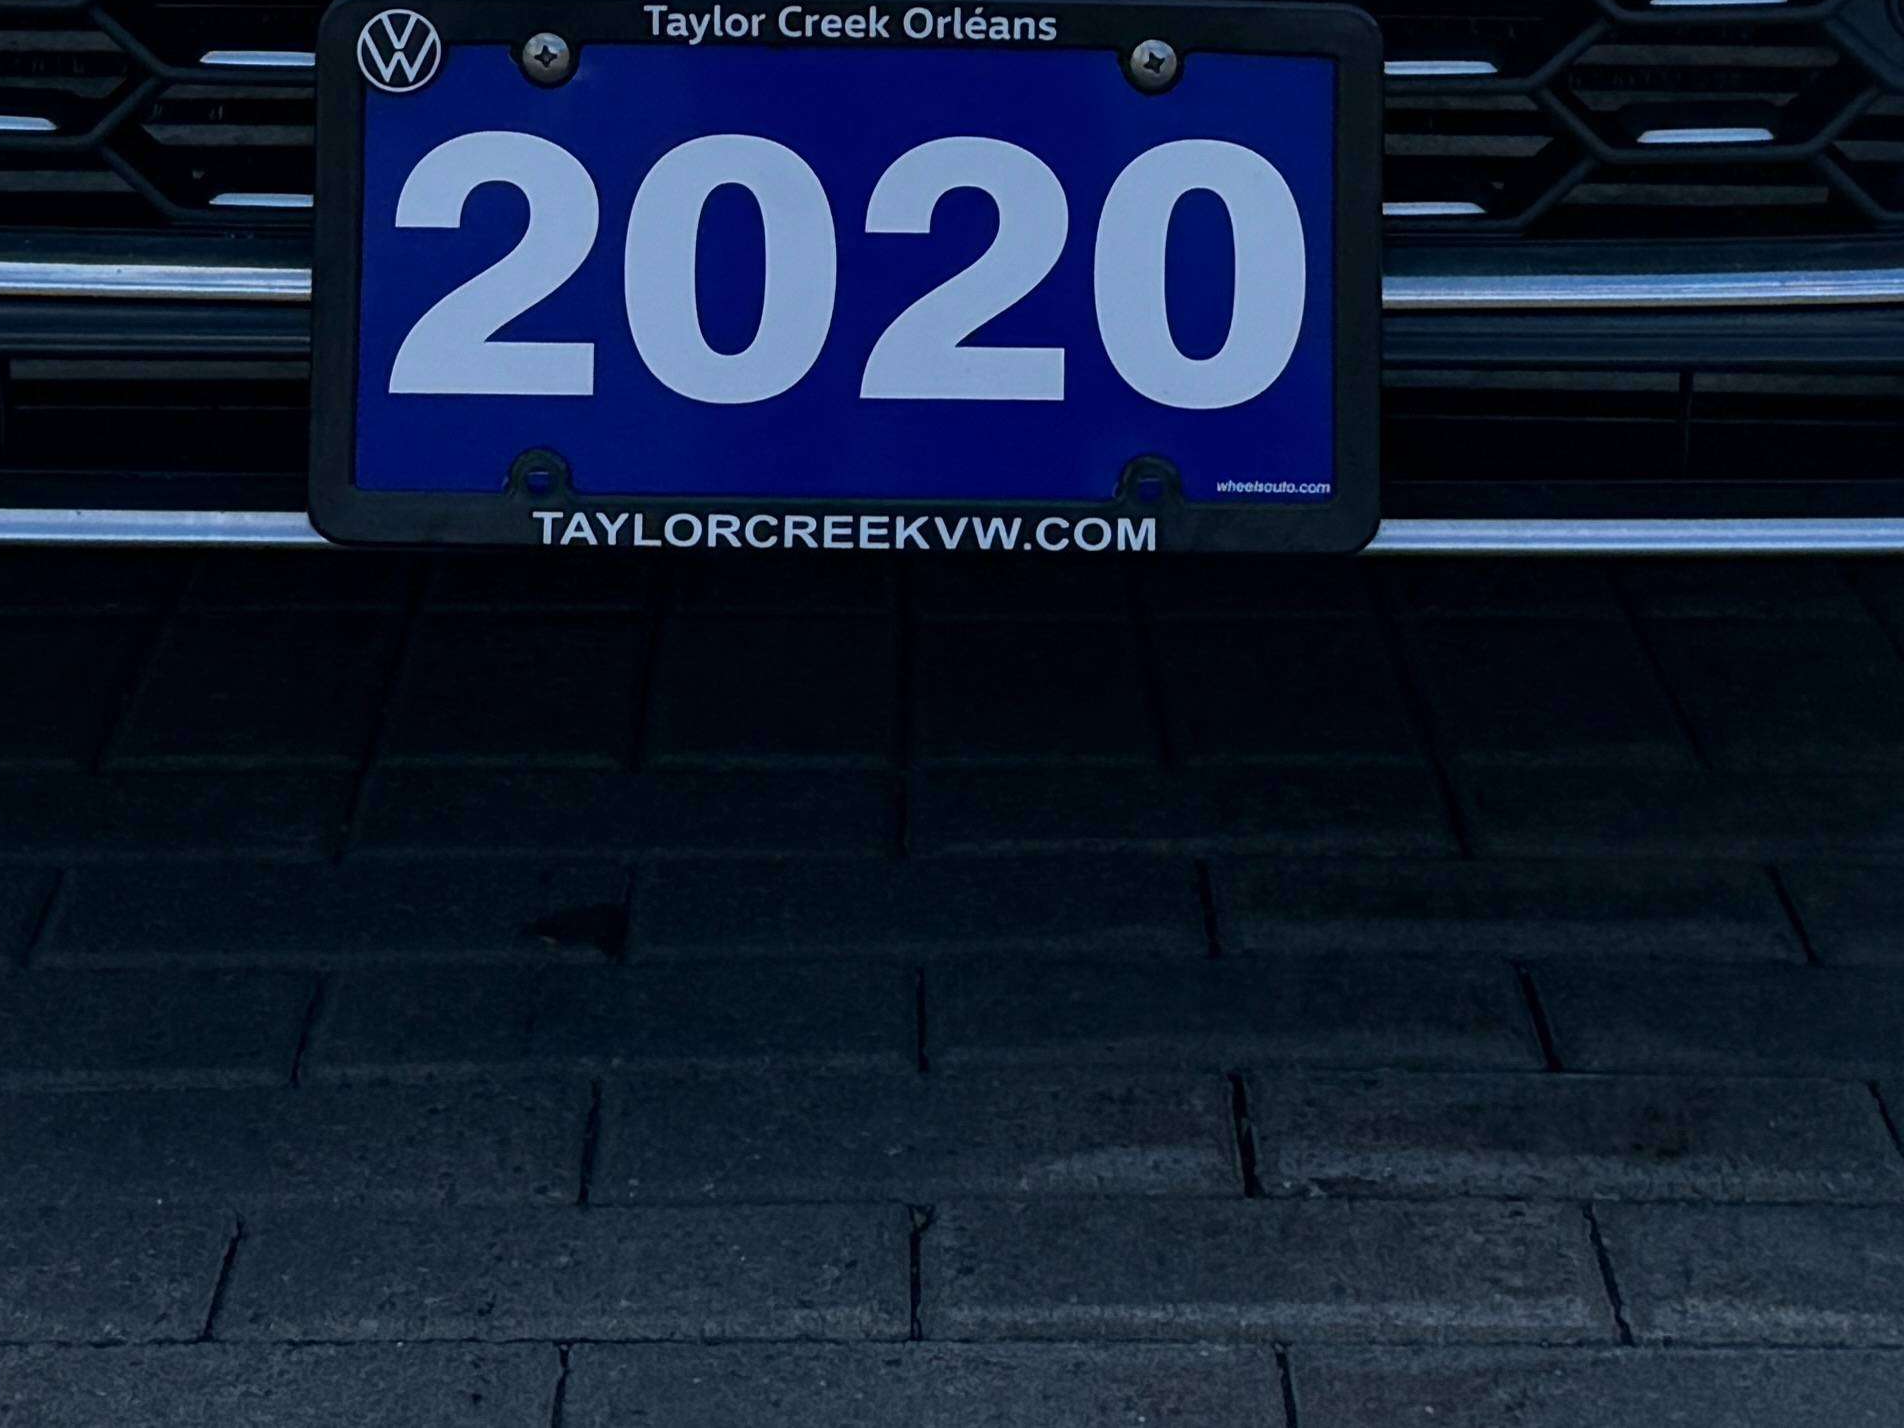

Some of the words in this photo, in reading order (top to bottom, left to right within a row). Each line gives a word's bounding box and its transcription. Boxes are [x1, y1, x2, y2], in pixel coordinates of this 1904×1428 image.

[643, 4, 766, 45] Taylor
[778, 5, 890, 39] Creek
[903, 6, 1057, 41] Orléans
[388, 130, 1307, 410] 2020
[532, 510, 1157, 552] TAYLORCREEKVW.COM
